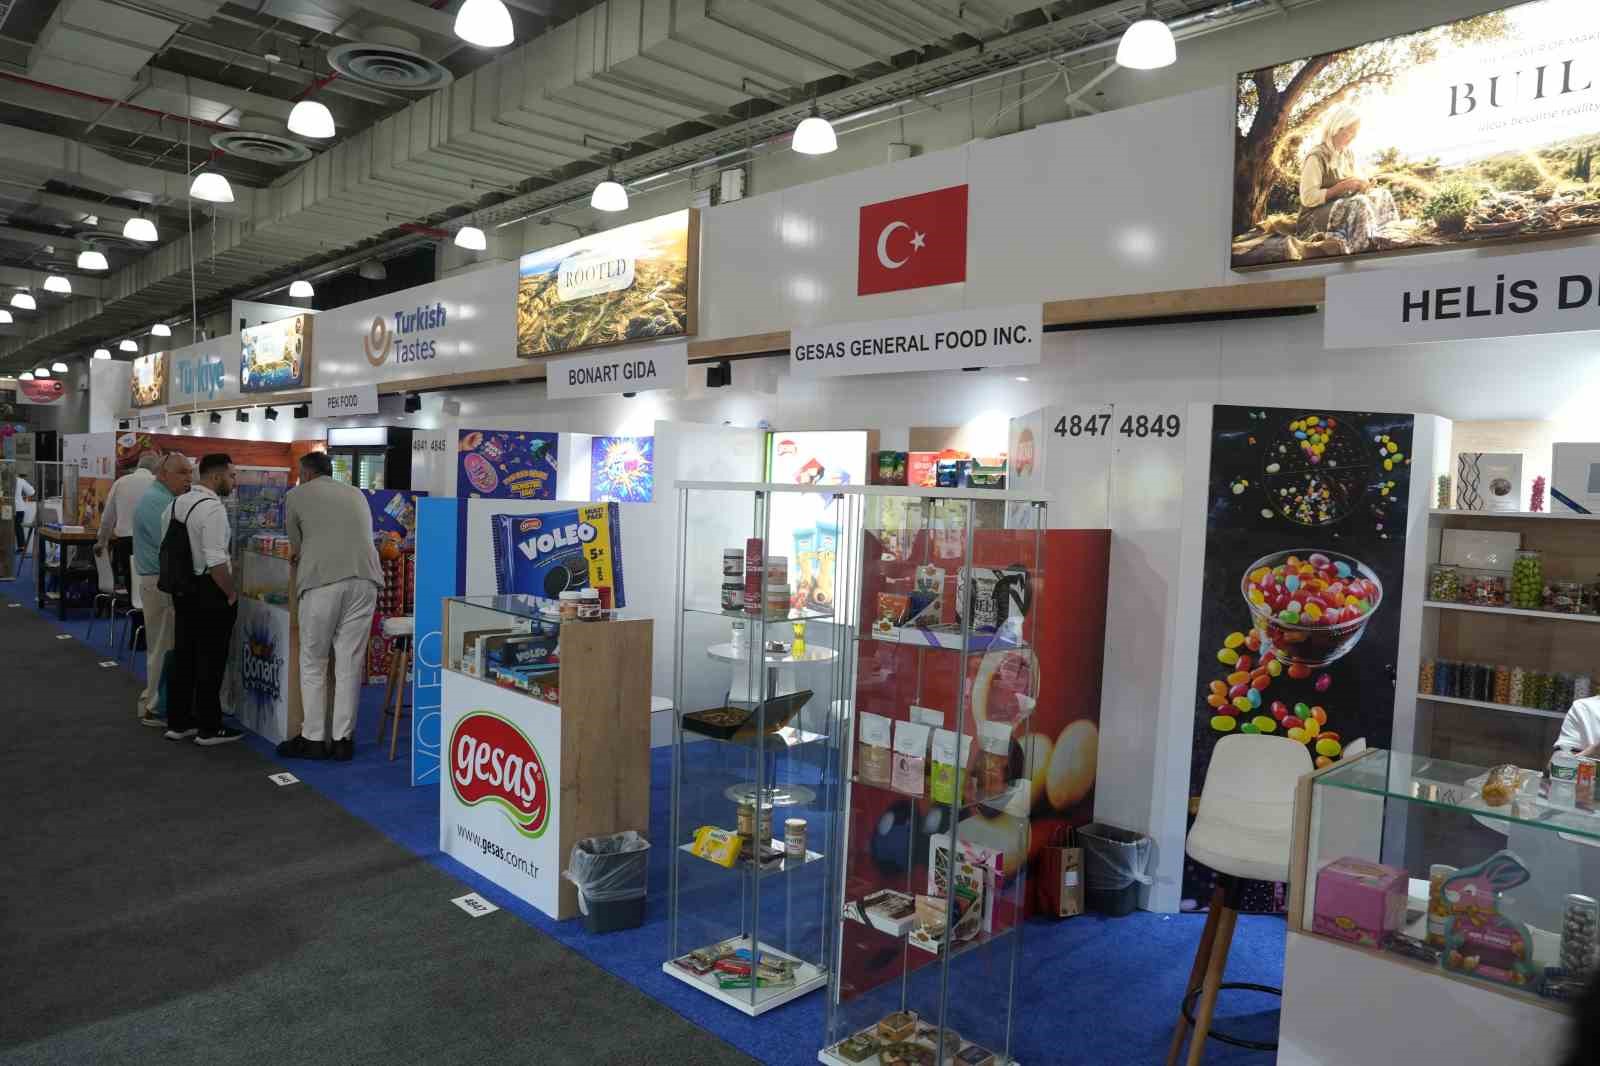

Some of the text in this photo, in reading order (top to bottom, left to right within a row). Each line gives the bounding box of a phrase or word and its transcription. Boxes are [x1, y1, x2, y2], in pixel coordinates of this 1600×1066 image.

[565, 257, 627, 289] ROOTED
[1558, 273, 1600, 310] D
[394, 302, 448, 335] Turkish
[393, 338, 437, 364] Tastes
[795, 324, 1033, 361] GESAS GENERAL FOOD INC.
[568, 359, 657, 386] BONART GIDA
[1054, 414, 1181, 437] 4847 4849
[518, 522, 597, 561] VOLEO
[457, 823, 540, 879] www.gesas.com.tr
